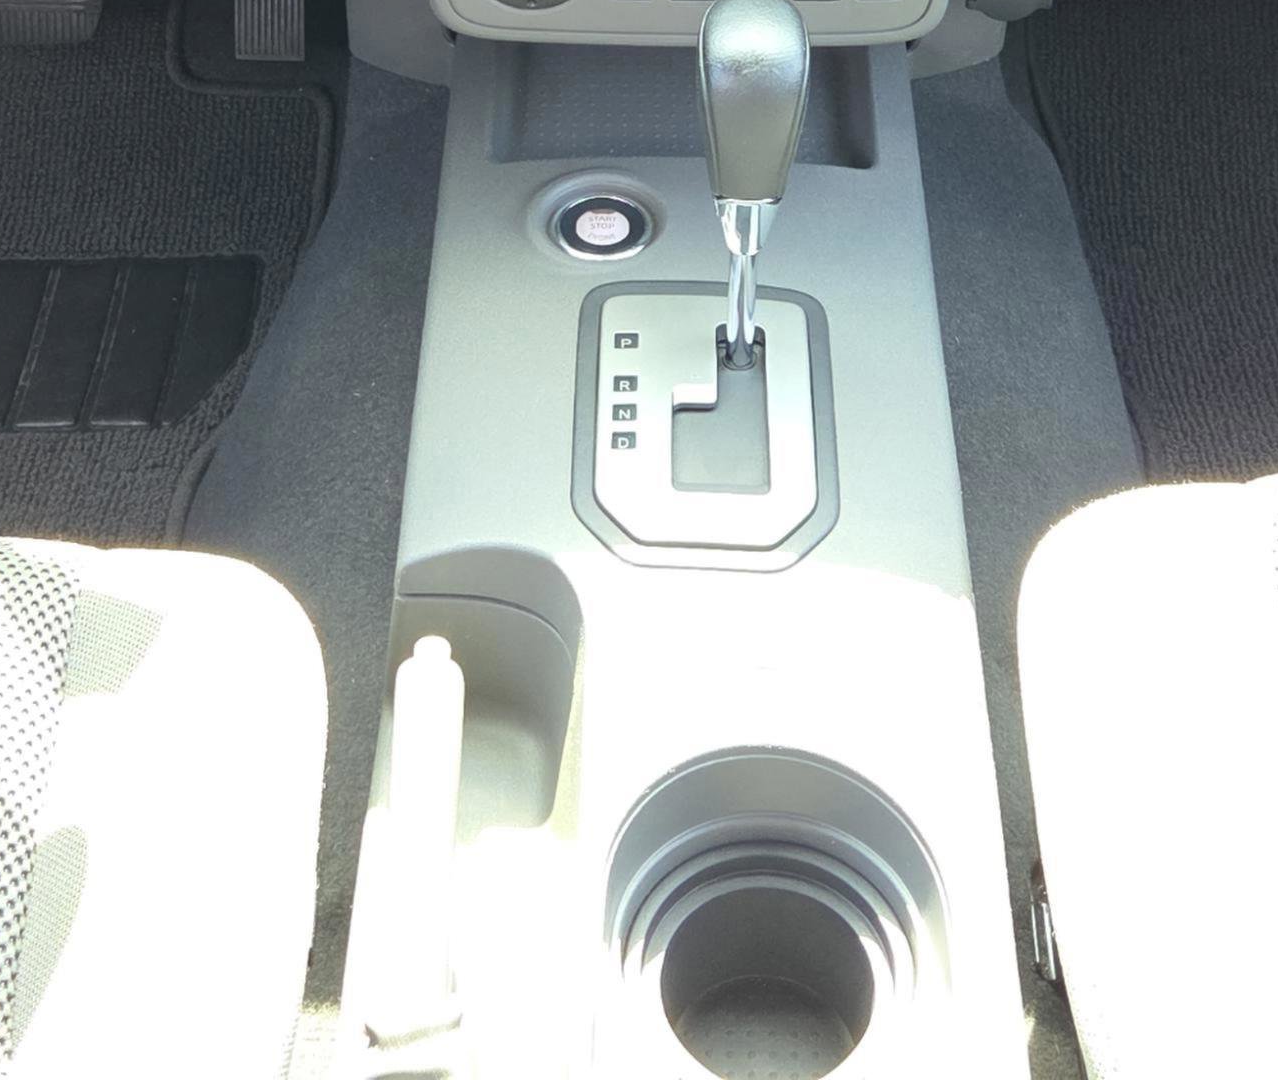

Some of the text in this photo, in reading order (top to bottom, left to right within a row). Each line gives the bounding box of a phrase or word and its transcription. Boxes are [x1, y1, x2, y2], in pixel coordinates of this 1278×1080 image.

[620, 338, 632, 349] P
[619, 380, 631, 391] R
[618, 409, 631, 419] N
[617, 437, 629, 448] D
